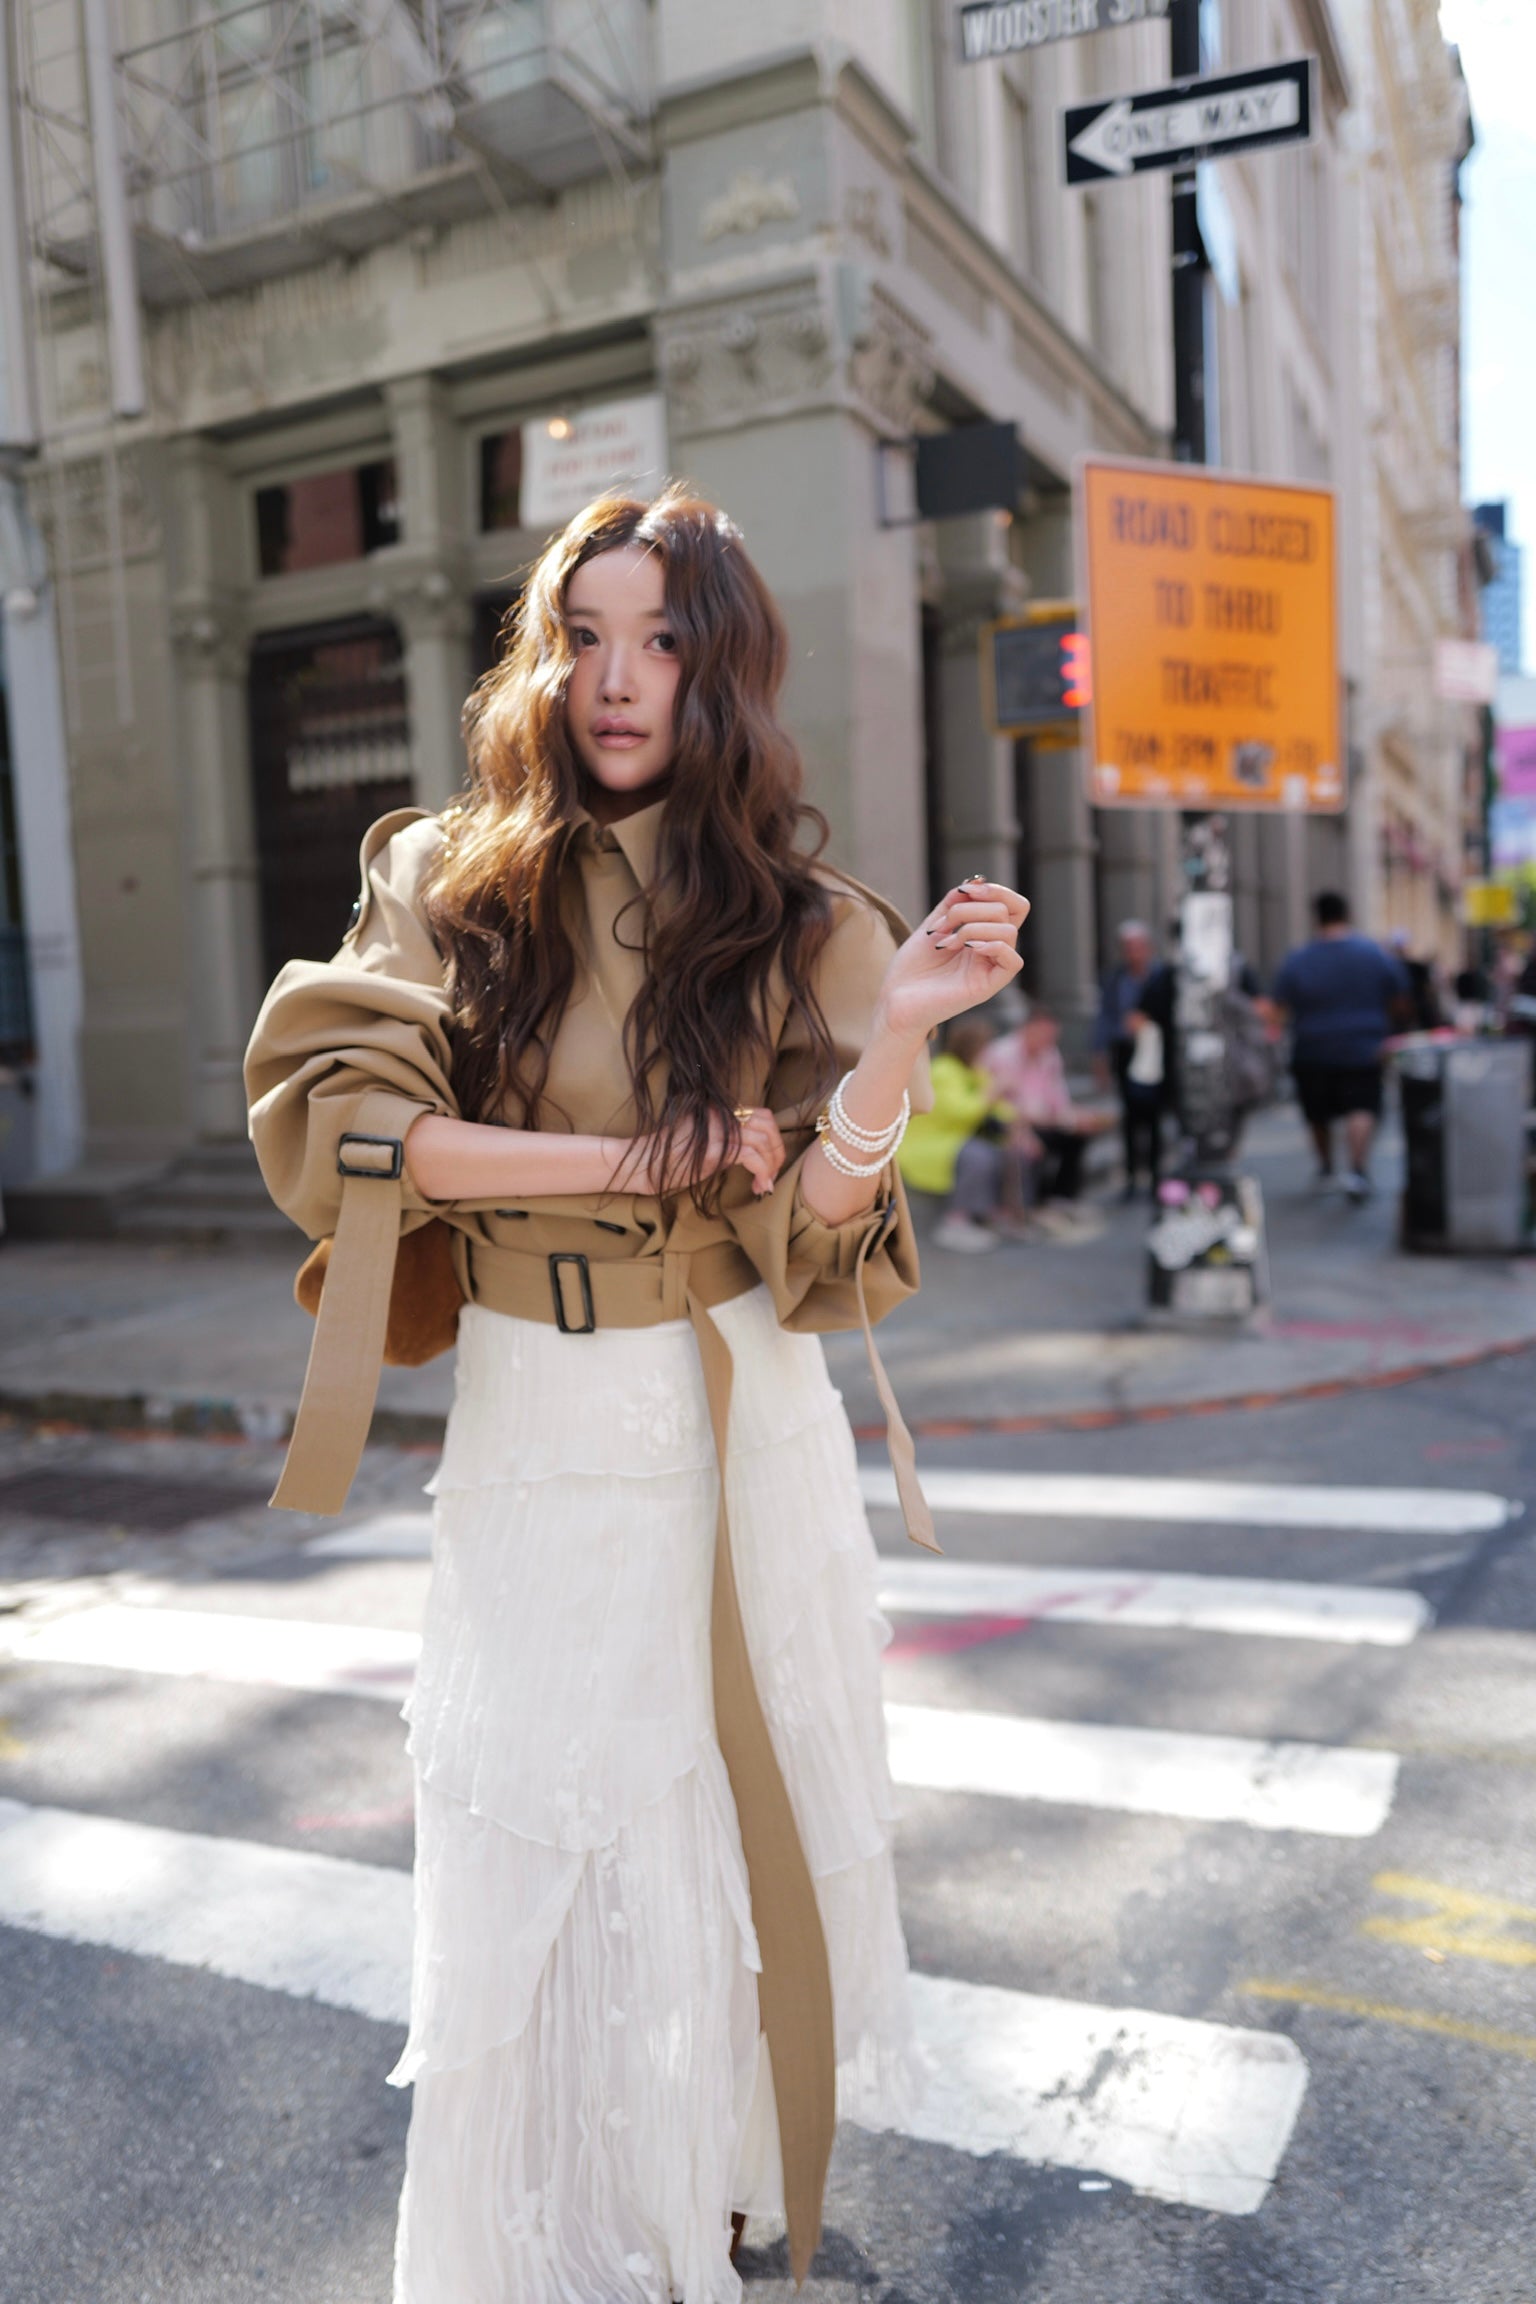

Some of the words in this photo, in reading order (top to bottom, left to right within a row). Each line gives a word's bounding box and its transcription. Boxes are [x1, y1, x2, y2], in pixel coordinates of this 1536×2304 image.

[1102, 112, 1181, 154] ONE
[1198, 89, 1281, 131] WAY
[1109, 496, 1196, 550] ROAD
[1206, 506, 1318, 564] CLOSED
[1153, 577, 1195, 629] TO
[1203, 582, 1282, 636] THRU
[1160, 657, 1278, 712] TRAFFIC
